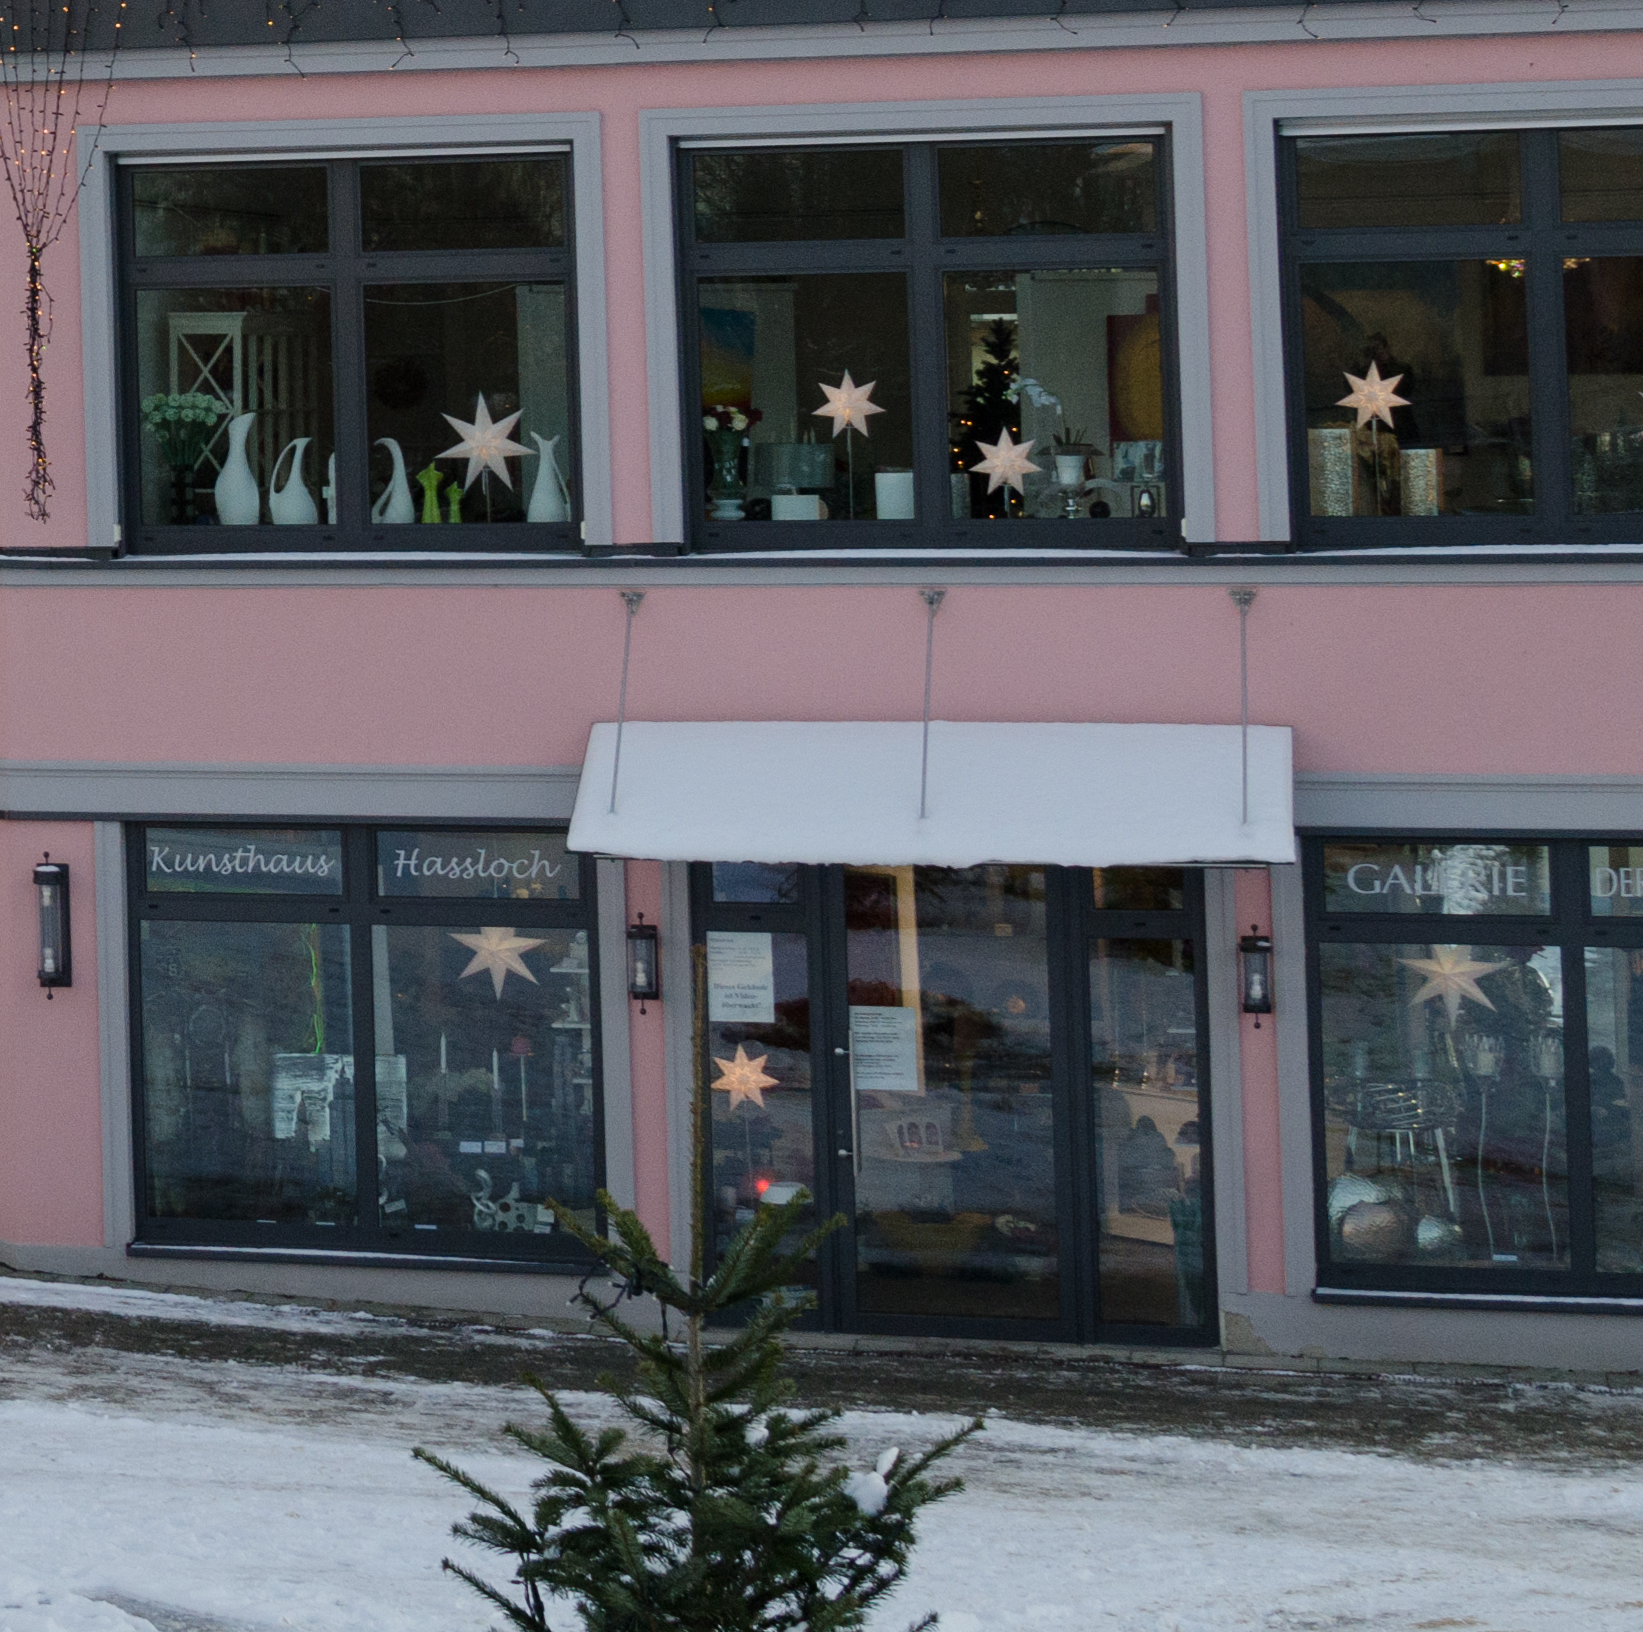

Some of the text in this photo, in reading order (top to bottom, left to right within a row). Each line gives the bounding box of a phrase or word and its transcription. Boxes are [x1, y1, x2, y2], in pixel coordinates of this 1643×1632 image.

[150, 845, 562, 880] Kunsthaus Hassloch
[1347, 862, 1527, 897] GALERIE
